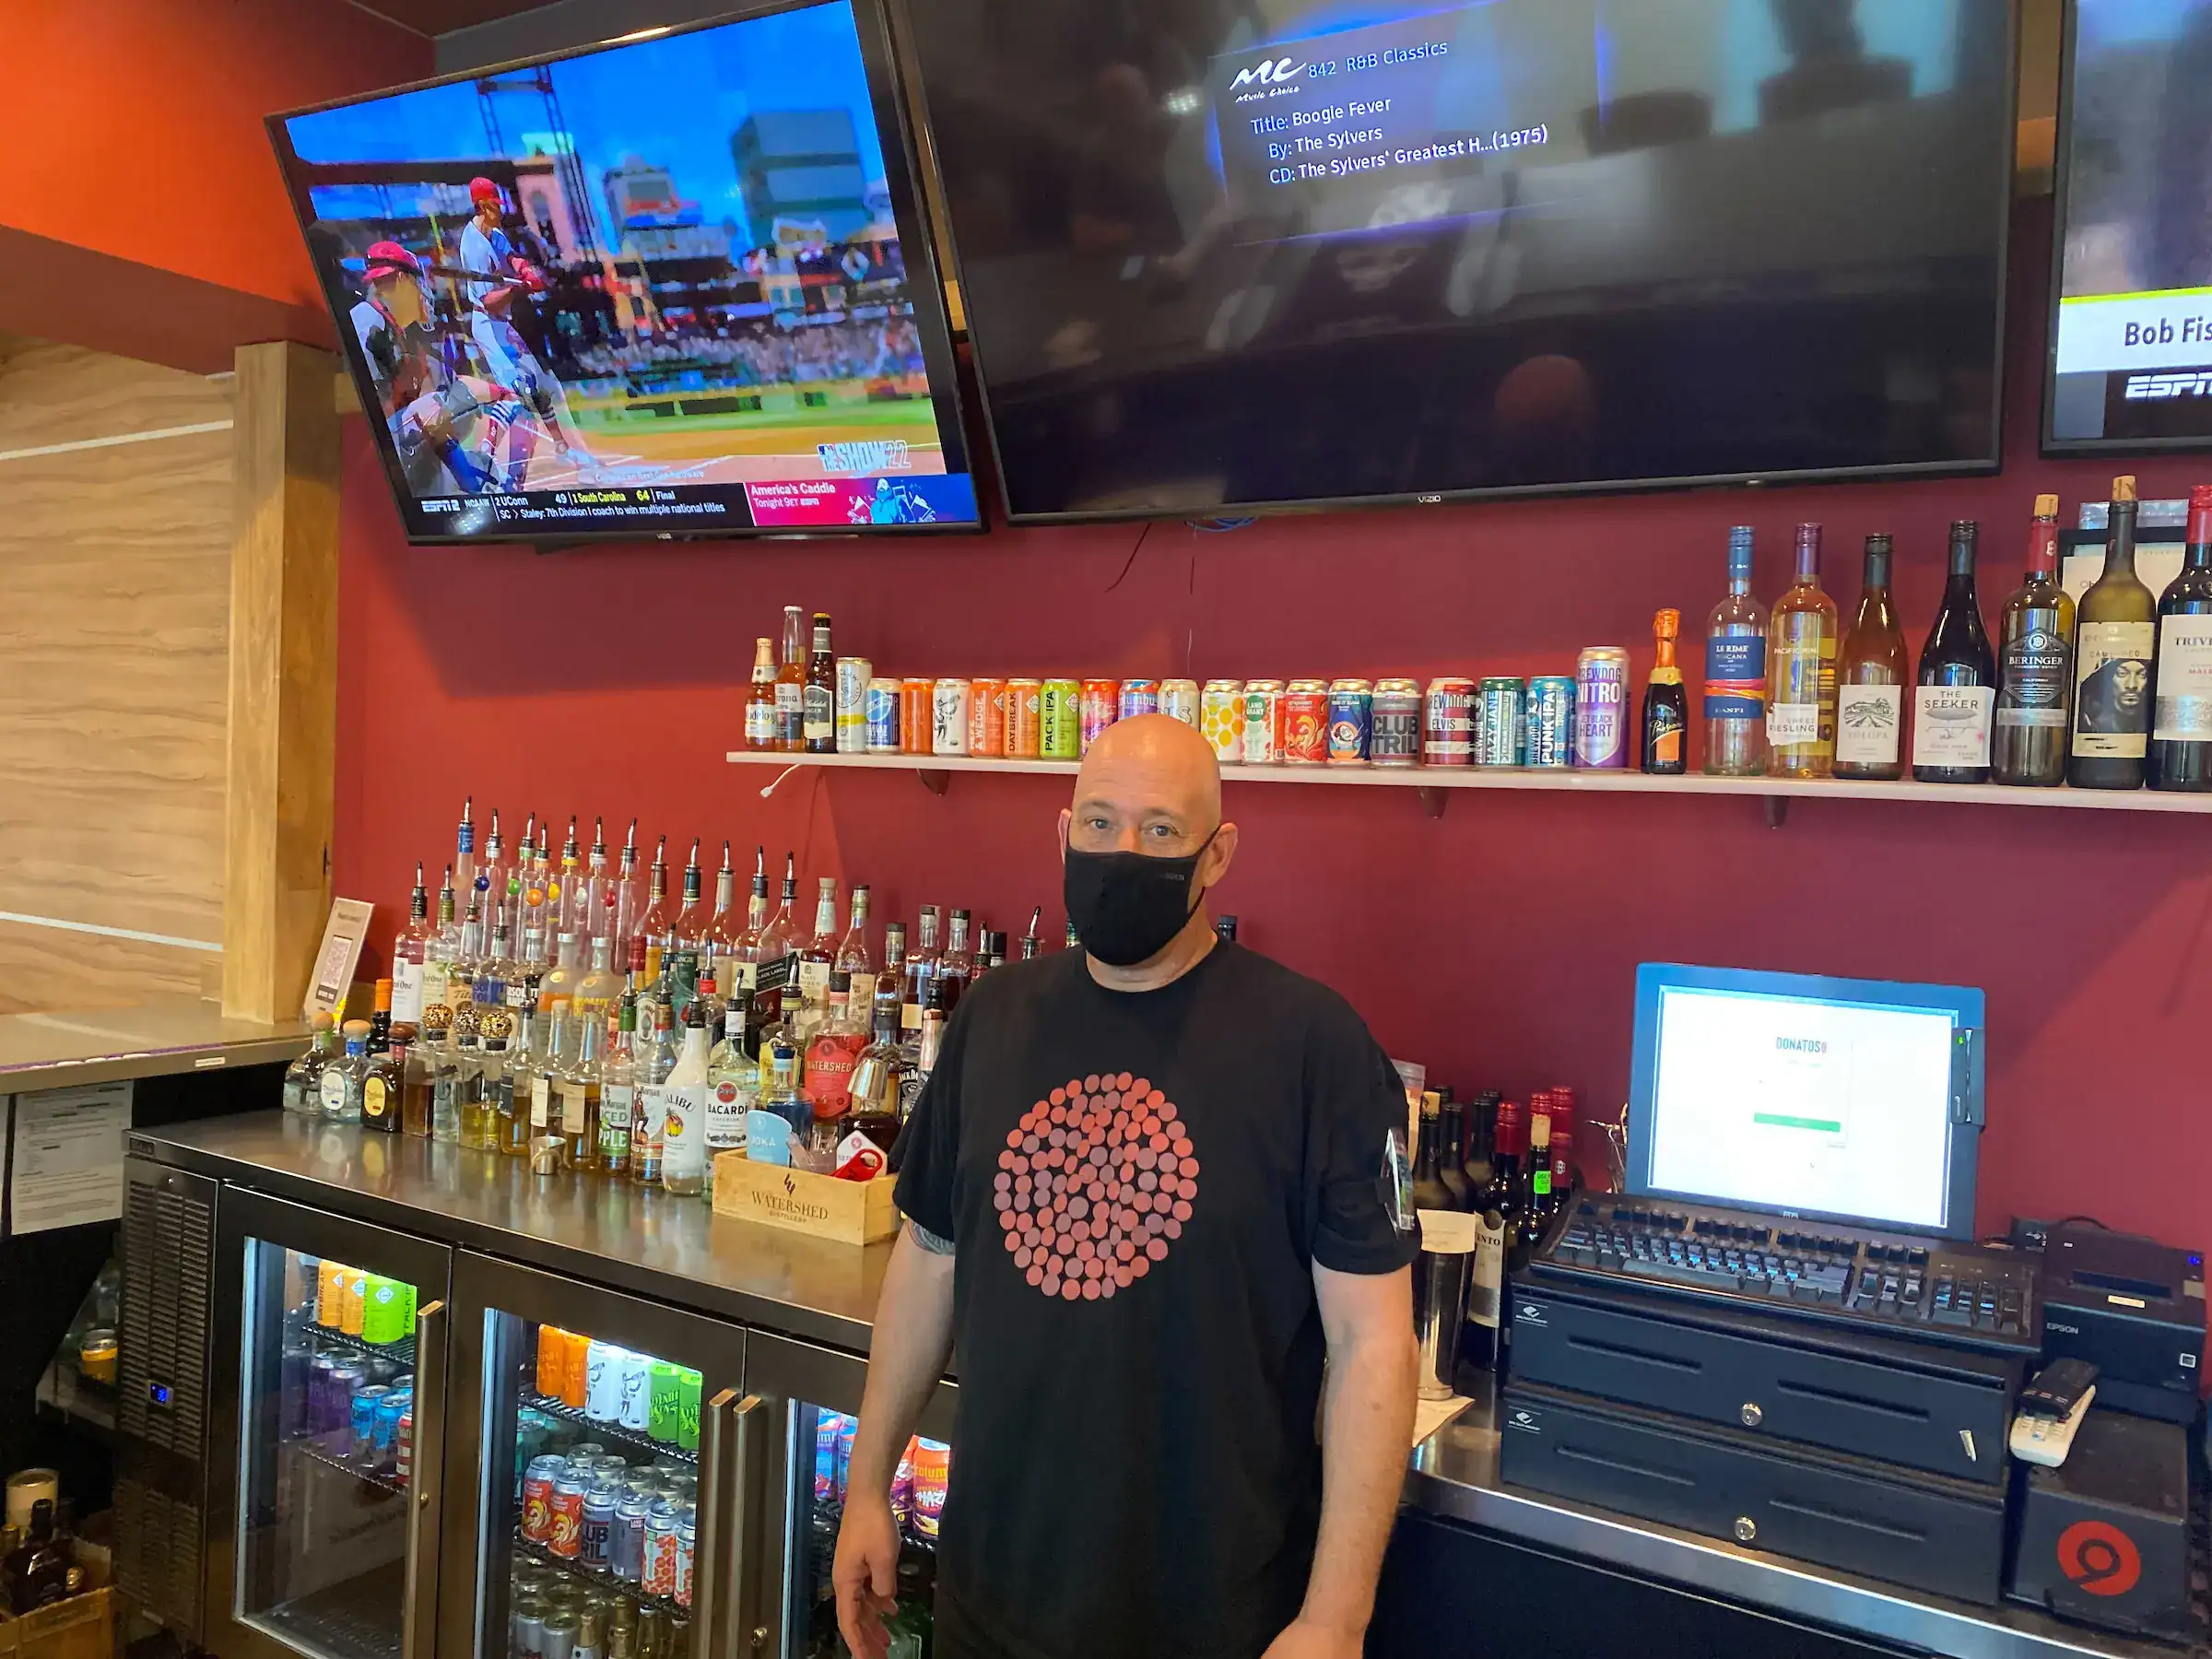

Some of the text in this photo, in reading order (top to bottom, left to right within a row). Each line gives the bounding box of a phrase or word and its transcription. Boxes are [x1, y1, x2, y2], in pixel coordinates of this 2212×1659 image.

[1308, 41, 1449, 79] 842 R&B Classics
[1234, 84, 1300, 104] Music Choice
[1251, 97, 1392, 135] Title: Boogie Fever
[1268, 126, 1383, 159] By: The Sylvers
[1269, 167, 1297, 184] CD:
[1297, 159, 1327, 181] The
[1329, 149, 1391, 176] Sylvers'
[1394, 139, 1465, 164] Greatest
[2124, 317, 2174, 347] Bob
[577, 491, 597, 503] South
[597, 490, 627, 503] Carolina
[635, 489, 651, 502] 64
[655, 489, 677, 501] Final
[750, 482, 836, 497] America's Caddie
[500, 495, 530, 507] UConn
[555, 494, 568, 504] 49
[752, 497, 784, 510] Tonight
[499, 509, 512, 520] SC
[546, 507, 559, 518] 7th
[559, 505, 588, 517] Division
[592, 505, 616, 516] coach
[615, 505, 624, 515] to
[624, 505, 639, 514] win
[638, 503, 671, 516] multiple
[670, 501, 704, 515] national
[703, 501, 725, 514] titles
[1715, 644, 1725, 653] LE
[2009, 656, 2064, 665] BERINGER
[1429, 694, 1468, 708] REWDOG
[1940, 690, 1962, 699] THE
[1924, 700, 1979, 709] SEEKER
[1246, 708, 1265, 716] GRANT
[1591, 713, 1613, 724] BLACK
[1008, 693, 1017, 752] DAYBREAK
[1044, 691, 1054, 751] PACK IPA
[1372, 716, 1418, 735] CLUB
[1431, 718, 1456, 731] ELVIS
[1487, 691, 1499, 764] HAZY JANE
[1541, 691, 1556, 764] PUNK IPA
[1579, 724, 1613, 737] HEART
[1372, 735, 1418, 754] TRIL
[453, 989, 472, 999] Tit
[1776, 1037, 1820, 1053] DONATOS
[806, 1060, 853, 1073] WATERSHED
[665, 1092, 696, 1113] ALIBU
[601, 1110, 629, 1123] ICED
[598, 1129, 628, 1147] PPLE
[751, 1190, 829, 1220] WATERSHED
[769, 1209, 807, 1224] DISTILLERY
[1476, 1232, 1501, 1246] ENTO
[2046, 1322, 2079, 1335] EPSON
